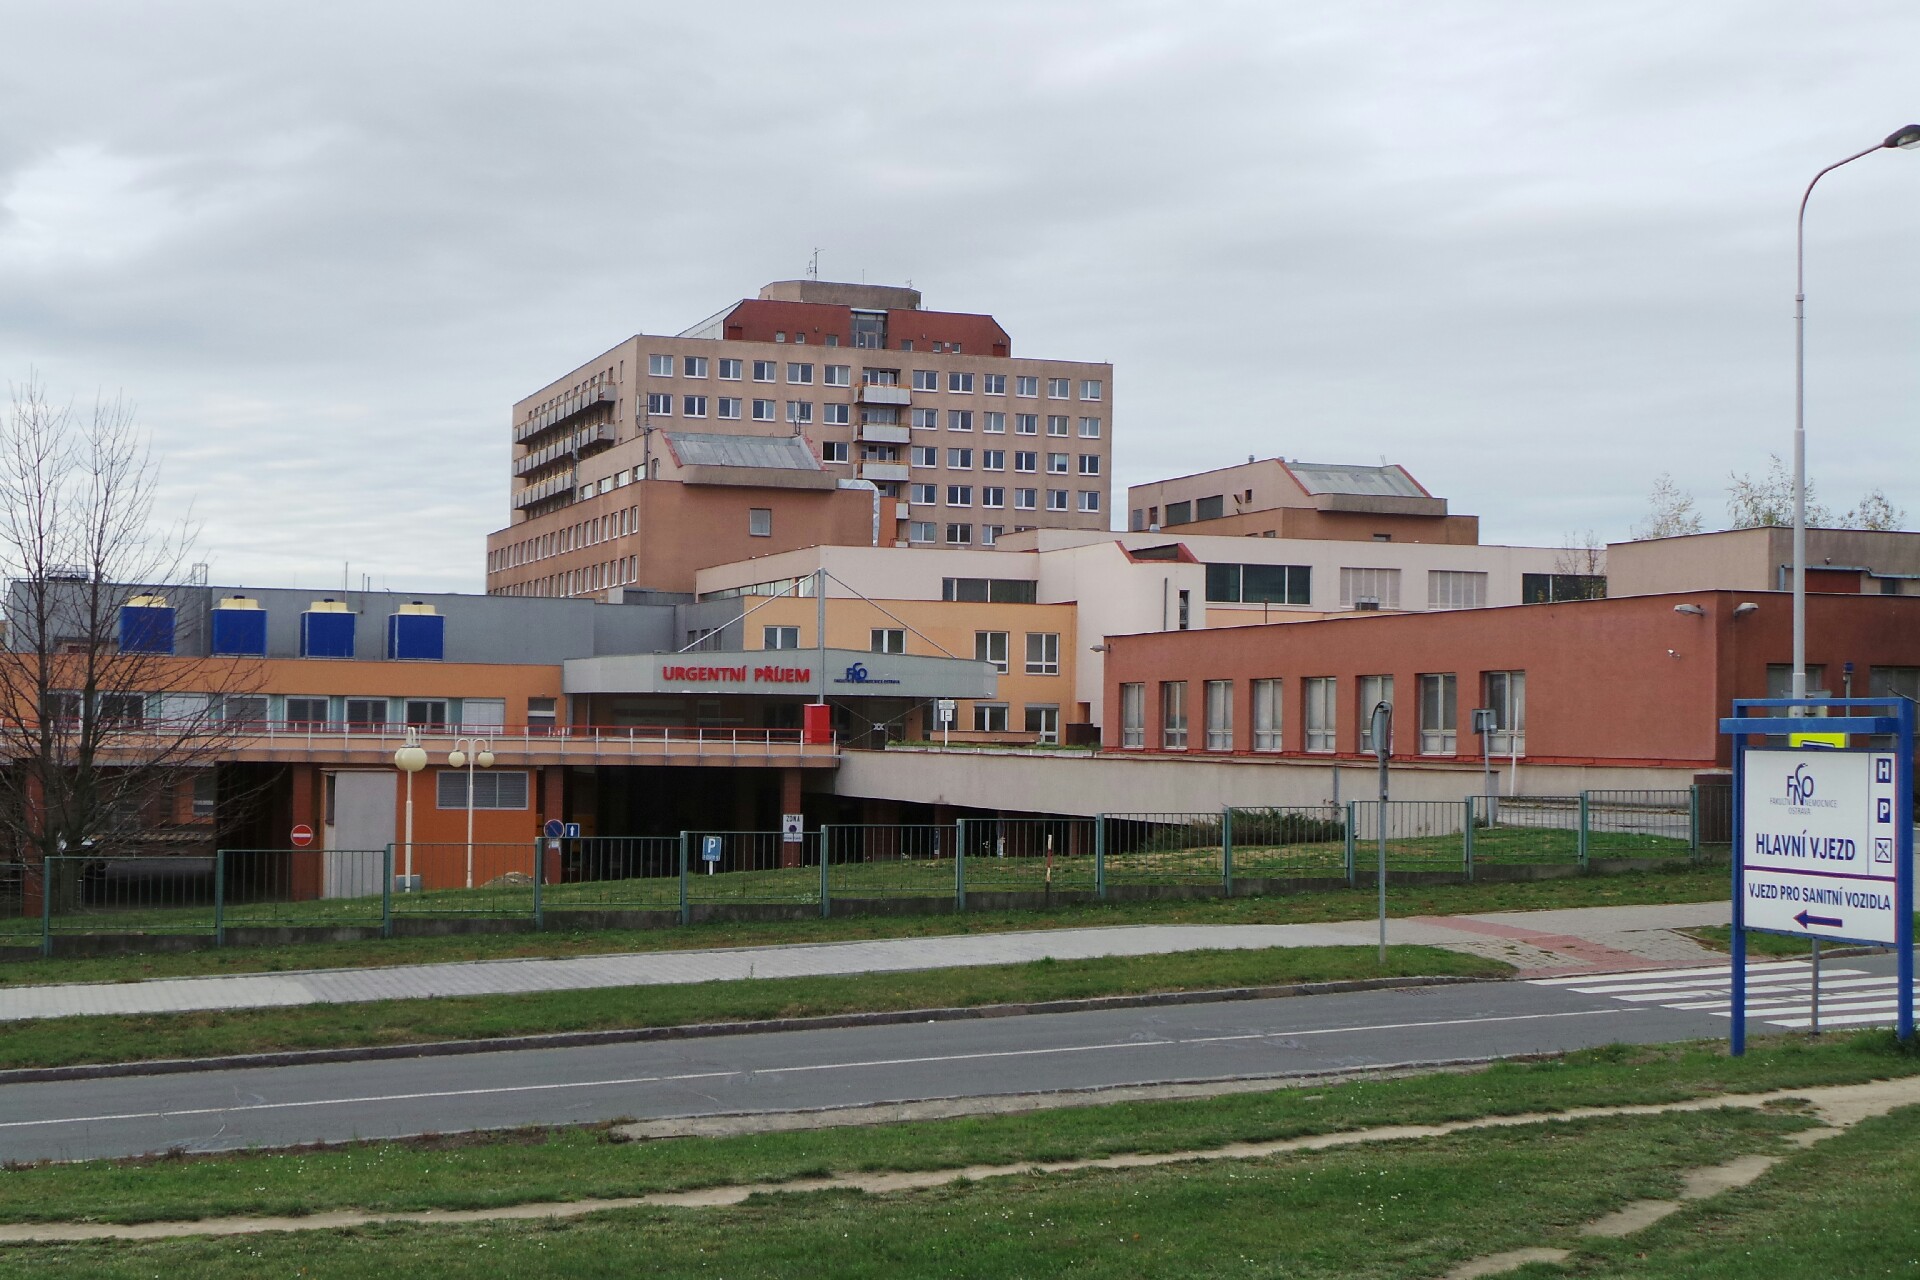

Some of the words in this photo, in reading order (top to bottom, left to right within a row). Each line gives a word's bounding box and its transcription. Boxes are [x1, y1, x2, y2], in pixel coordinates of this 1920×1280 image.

[662, 664, 747, 682] URGENTNÍ
[754, 664, 810, 683] PŘÍJEM
[1878, 761, 1890, 780] H
[1879, 801, 1890, 819] P
[707, 838, 716, 853] P
[1755, 829, 1807, 858] HLAVNÍ
[1809, 836, 1856, 861] VJEZD
[1748, 882, 1778, 900] VJEZD
[1780, 886, 1800, 901] PRO
[1802, 886, 1843, 906] SANITNÍ
[1845, 891, 1891, 911] VOZIDLA
